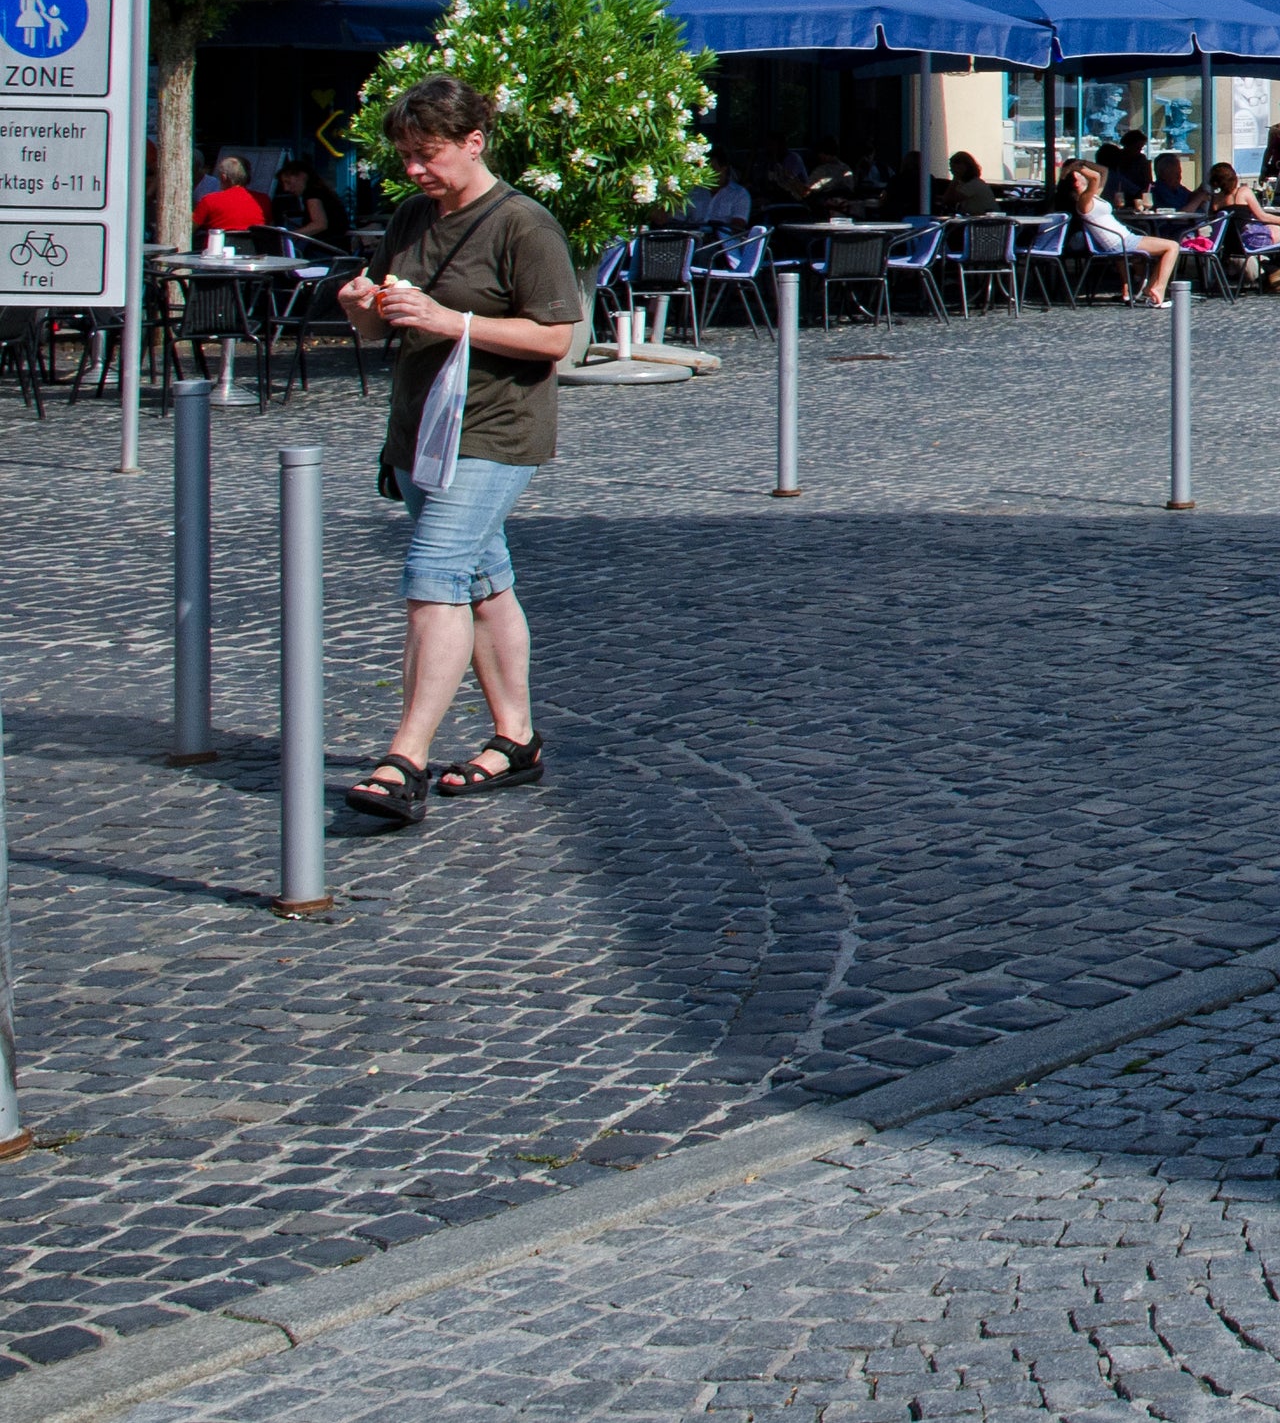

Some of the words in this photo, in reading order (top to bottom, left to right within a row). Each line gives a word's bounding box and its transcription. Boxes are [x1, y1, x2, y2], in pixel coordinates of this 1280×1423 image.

[5, 66, 75, 87] ZONE
[22, 146, 47, 162] frei
[93, 175, 101, 191] h
[22, 272, 55, 287] frei
